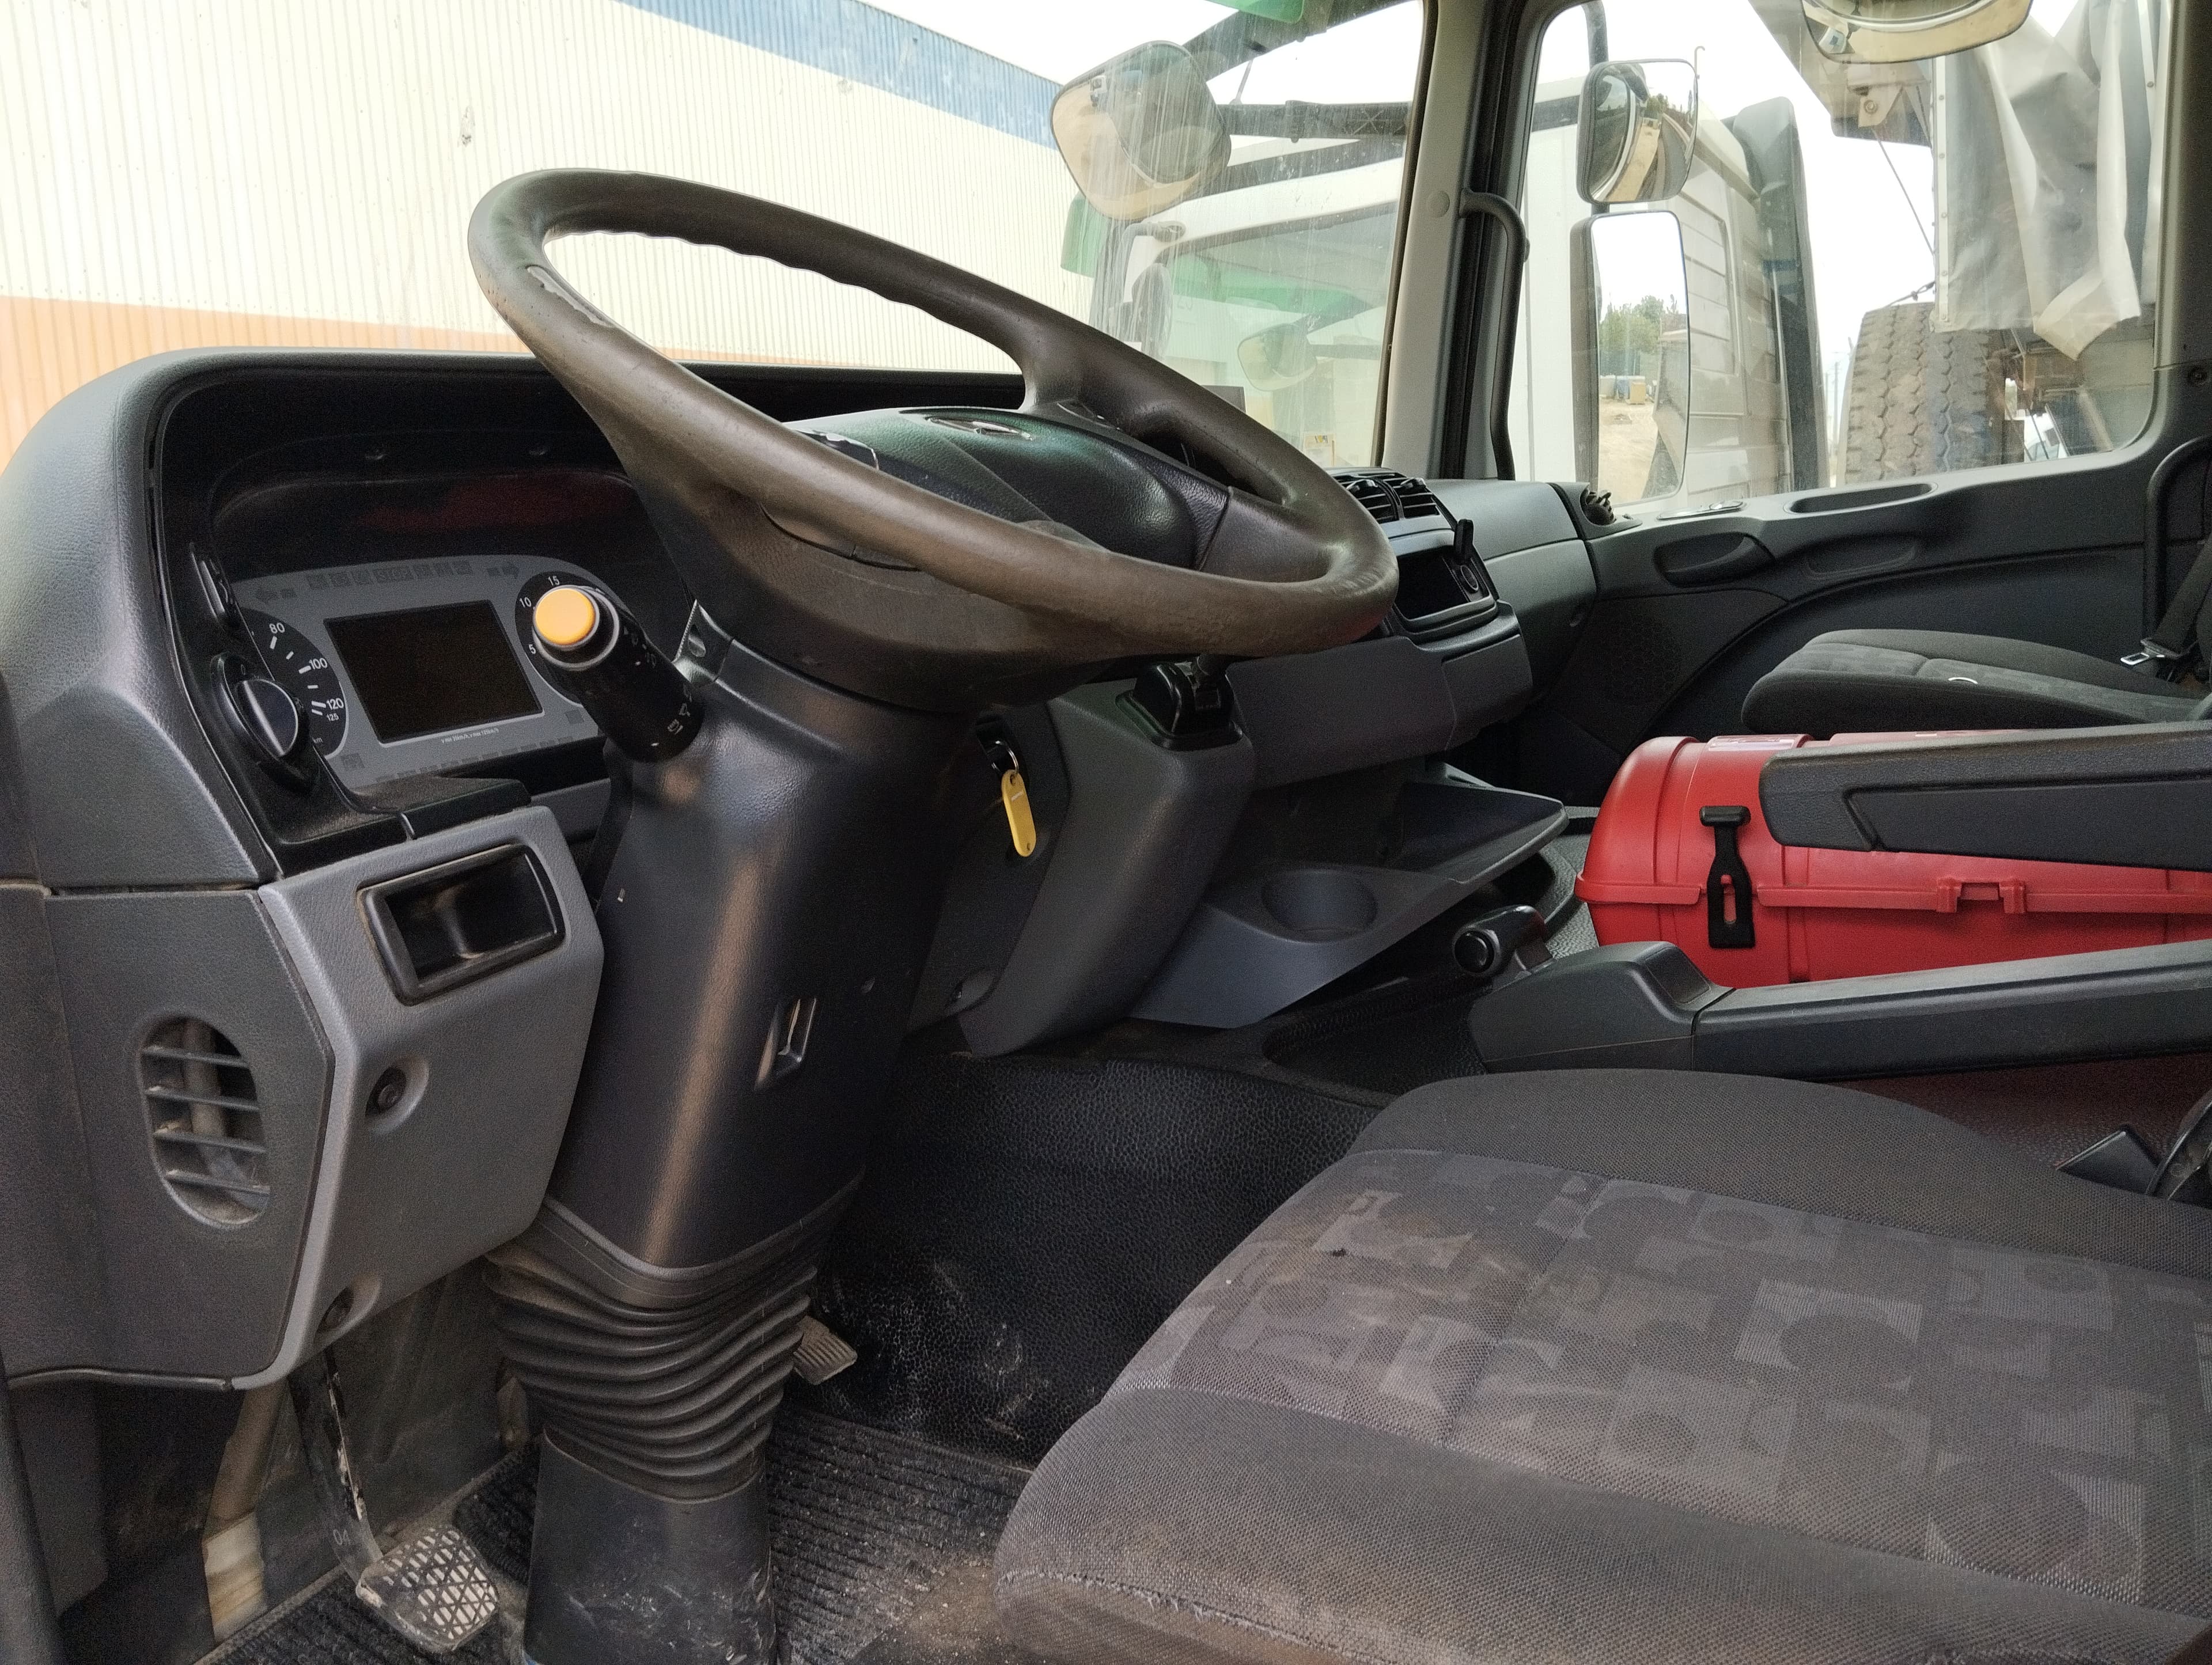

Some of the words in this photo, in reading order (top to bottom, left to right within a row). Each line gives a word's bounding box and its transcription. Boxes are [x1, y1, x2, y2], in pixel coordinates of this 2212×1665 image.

[548, 575, 560, 586] 15
[519, 596, 532, 608] 10
[269, 623, 285, 634] 80
[528, 643, 536, 654] 5
[309, 658, 328, 669] 100
[326, 697, 344, 710] 120
